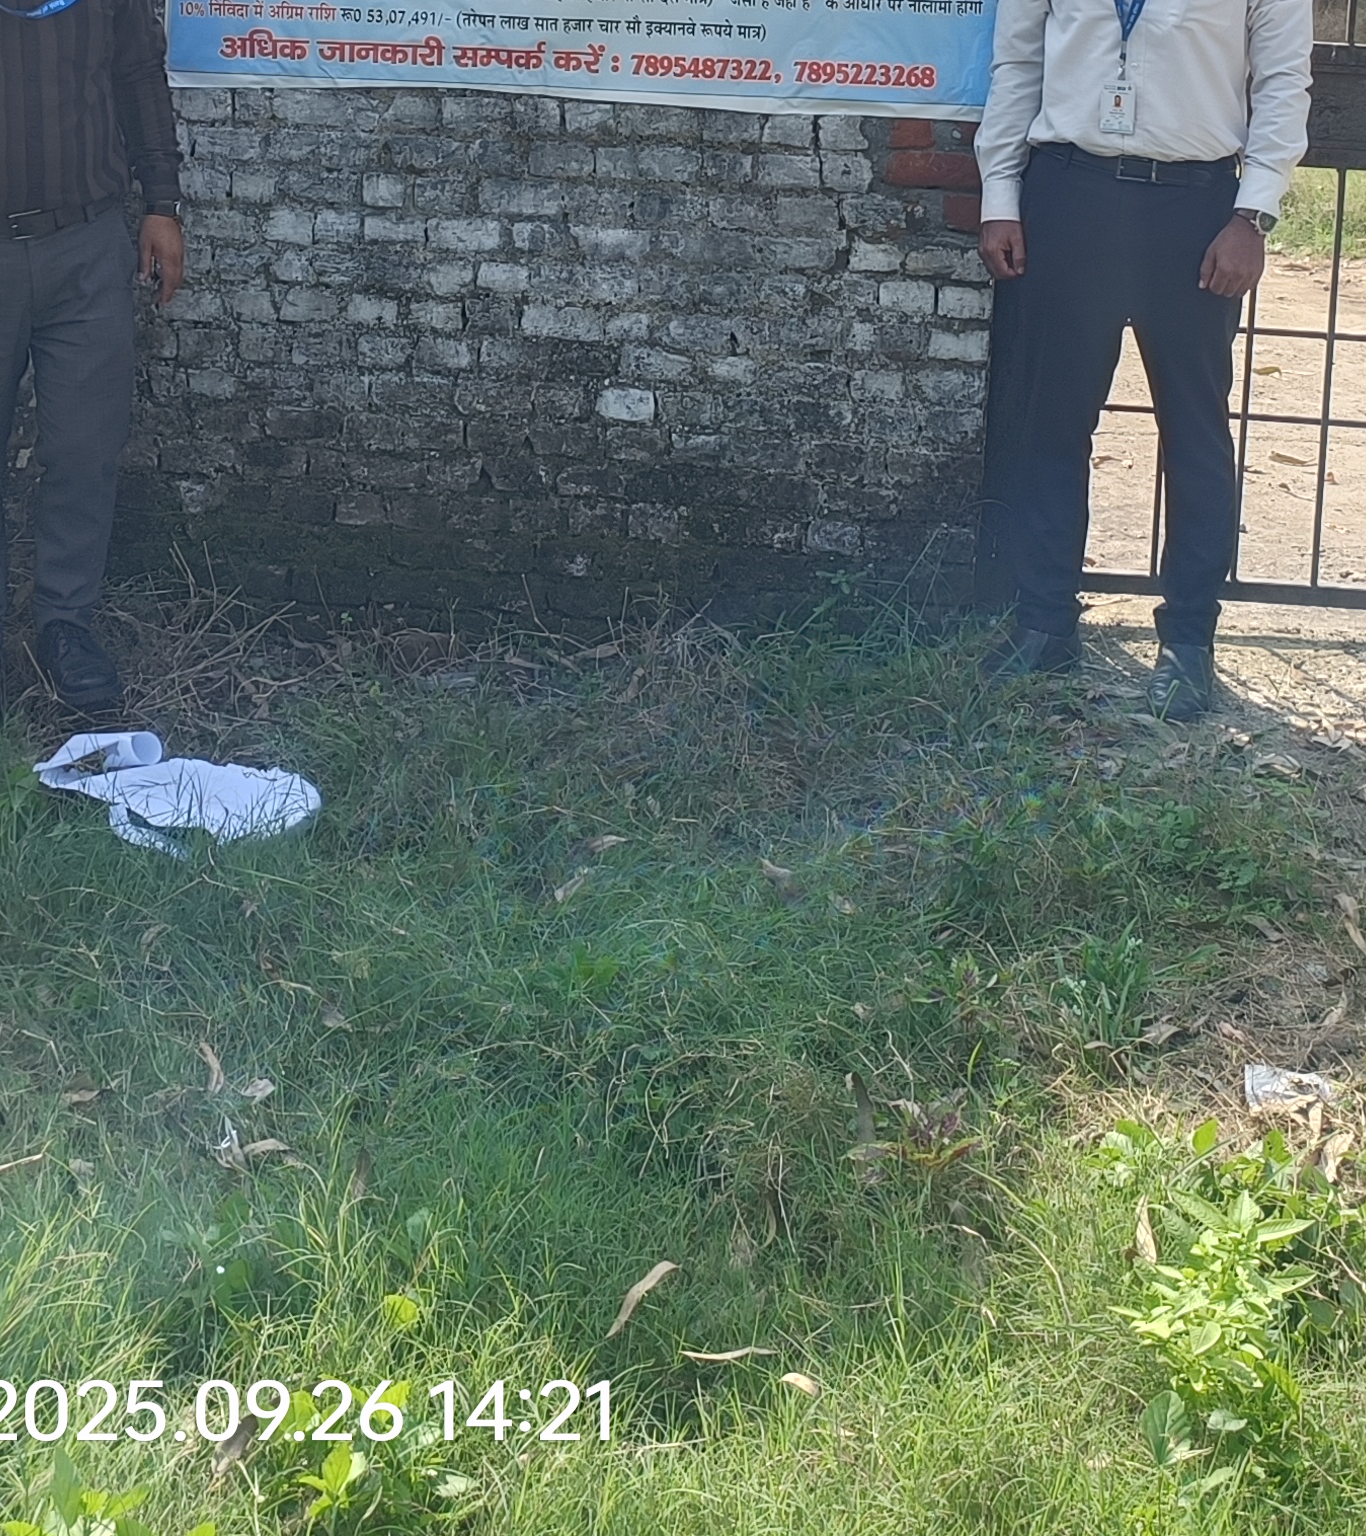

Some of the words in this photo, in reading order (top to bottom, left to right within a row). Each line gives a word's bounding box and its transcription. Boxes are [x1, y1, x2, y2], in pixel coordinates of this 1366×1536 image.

[179, 1, 205, 17] 10%
[253, 0, 264, 18] में
[268, 1, 304, 21] अग्रिम
[307, 1, 336, 22] राशि
[456, 8, 496, 30] (तरेपन
[499, 15, 530, 31] लाख
[534, 17, 558, 33] सात
[563, 17, 594, 35] हजार
[598, 19, 621, 35] चार
[625, 14, 642, 35] सौ
[645, 16, 697, 39] इक्यानवे
[700, 19, 733, 39] रूपये
[737, 23, 767, 43] मात्र)
[219, 28, 310, 61] अधिक
[316, 35, 446, 67] जानकारी
[453, 41, 546, 71] सम्पर्क
[552, 44, 606, 74] करें
[630, 54, 783, 84] 7895487322,
[793, 61, 936, 88] 7895223268
